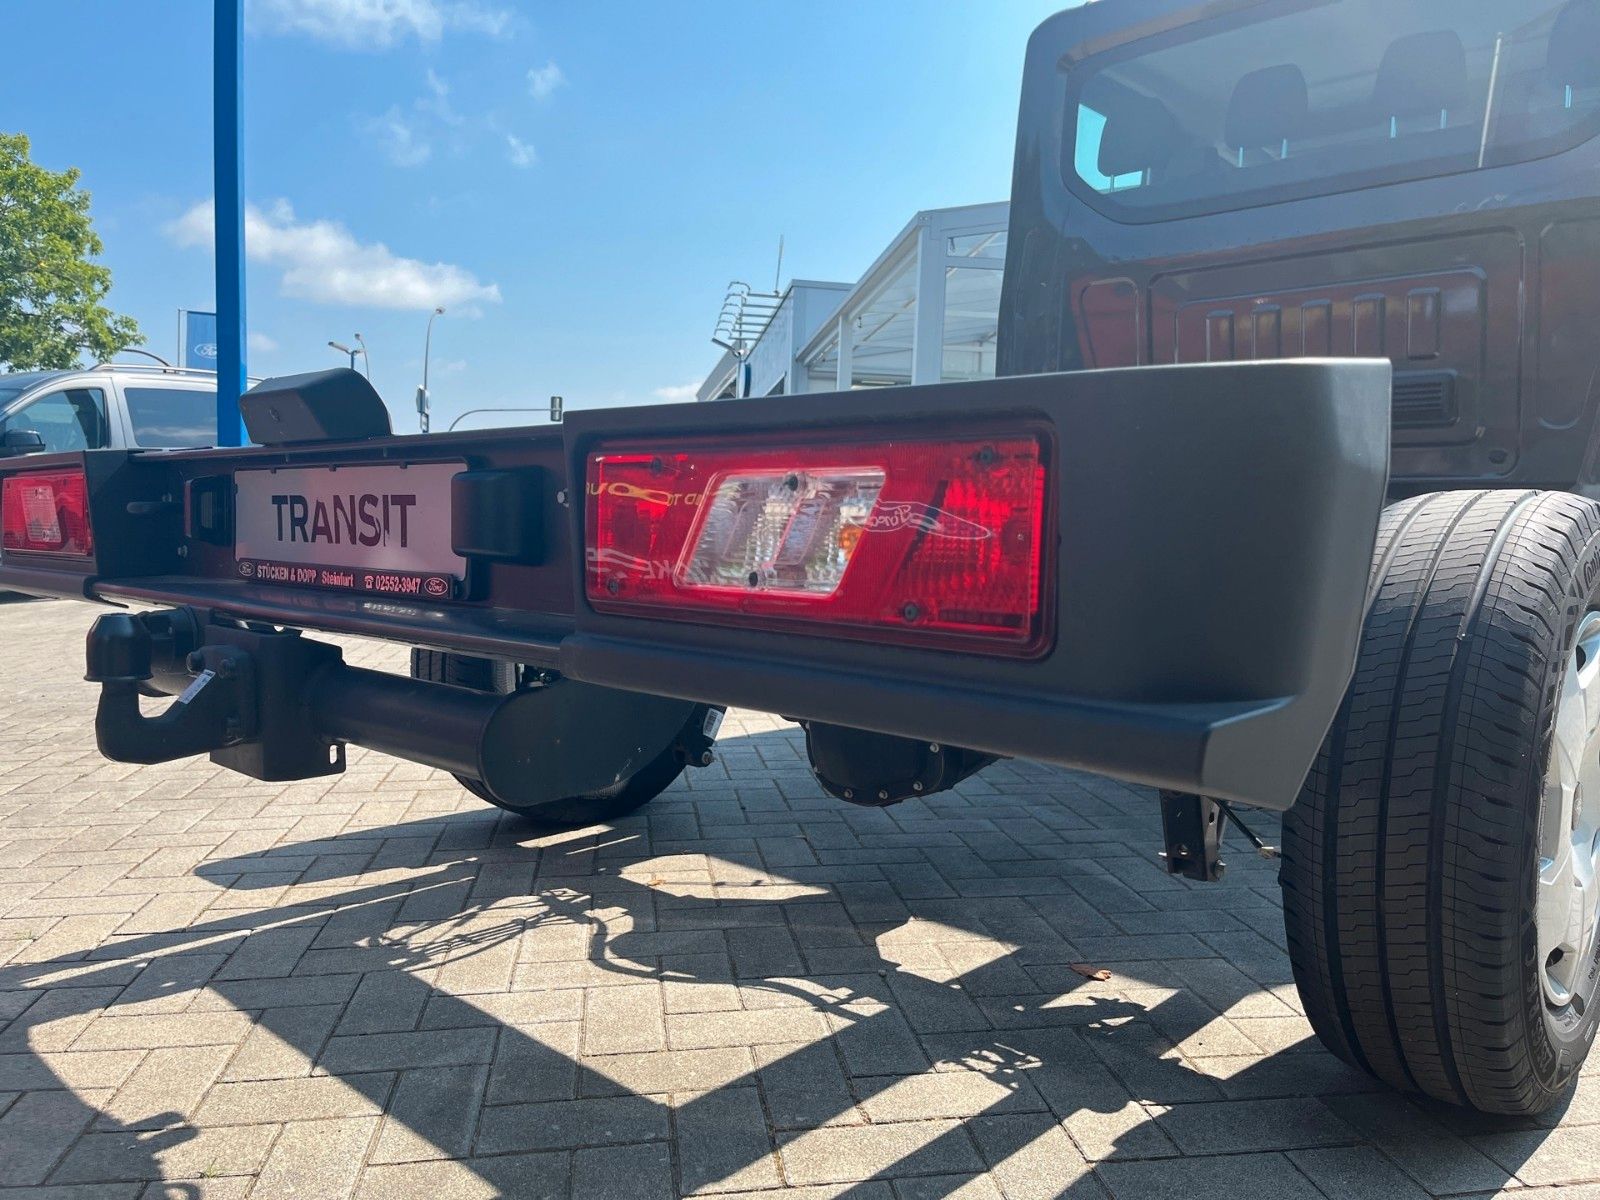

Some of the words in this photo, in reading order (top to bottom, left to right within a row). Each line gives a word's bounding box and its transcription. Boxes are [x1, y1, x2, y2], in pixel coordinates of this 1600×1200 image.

[272, 493, 416, 547] TRANSIT
[257, 563, 289, 581] STÜCKEN
[290, 567, 296, 581] &
[297, 568, 317, 583] DOPP
[322, 571, 354, 587] Steinfurt
[375, 575, 421, 594] 02552-3947
[427, 579, 445, 593] Ford
[1584, 543, 1600, 592] Conti
